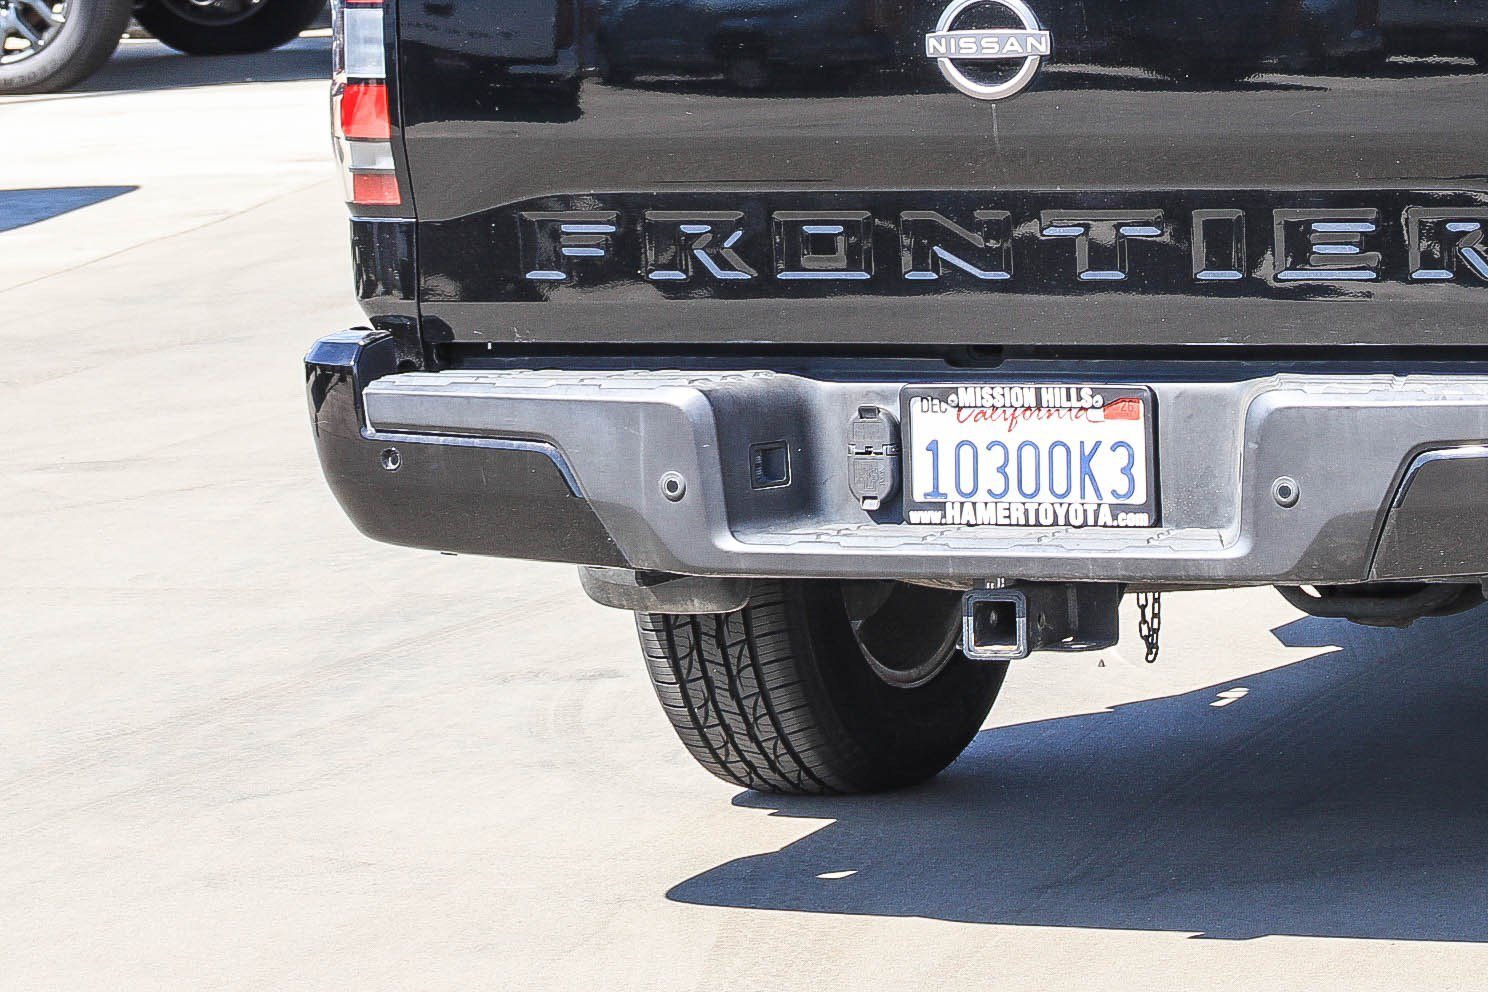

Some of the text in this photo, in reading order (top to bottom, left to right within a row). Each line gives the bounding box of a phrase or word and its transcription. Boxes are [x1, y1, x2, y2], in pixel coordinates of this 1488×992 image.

[928, 35, 1048, 55] NISSAN
[957, 387, 1093, 408] MISSION HILLS
[956, 406, 1105, 432] California
[923, 439, 1136, 500] 10300K3
[909, 501, 1149, 527] www.HAMERTOYOTA.com
